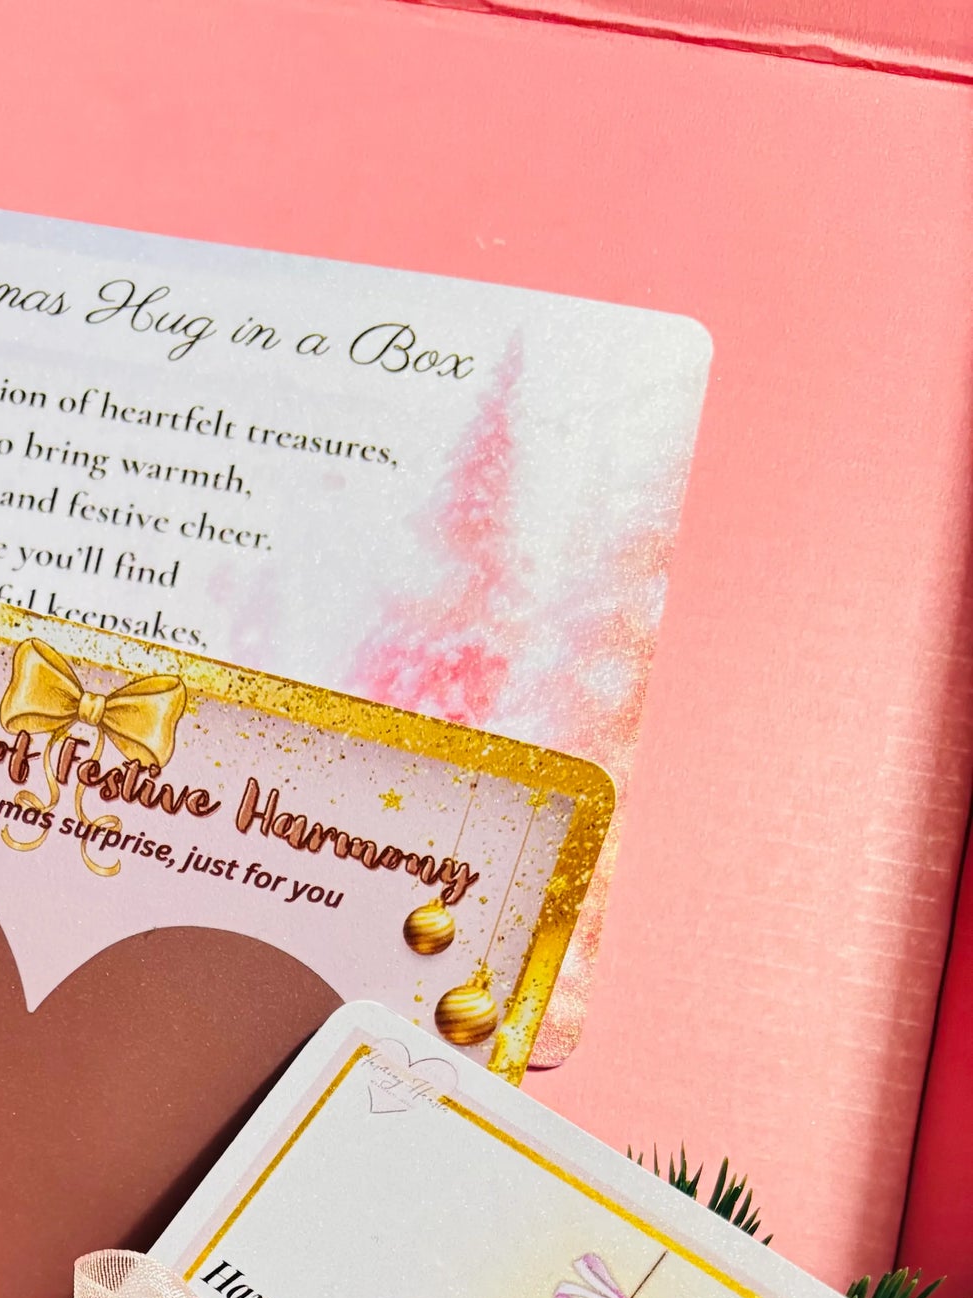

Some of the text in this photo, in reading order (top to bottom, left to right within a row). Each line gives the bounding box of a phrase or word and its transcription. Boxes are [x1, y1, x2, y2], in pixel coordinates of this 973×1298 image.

[85, 279, 216, 360] Hug
[230, 315, 281, 351] in
[295, 330, 330, 358] a
[349, 322, 475, 381] Box
[58, 386, 94, 417] of
[100, 391, 237, 442] heartfelt
[247, 423, 400, 468] treasures,
[25, 431, 110, 481] bring
[120, 458, 253, 498] warmth,
[67, 491, 170, 537] festive
[180, 513, 273, 552] cheer.
[113, 549, 180, 590] find
[47, 592, 208, 652] keepsakes,
[56, 736, 222, 821] Festive
[235, 777, 481, 906] Harmony
[59, 813, 178, 871] surprise,
[180, 845, 240, 883] just
[242, 860, 289, 891] for
[283, 877, 346, 910] you
